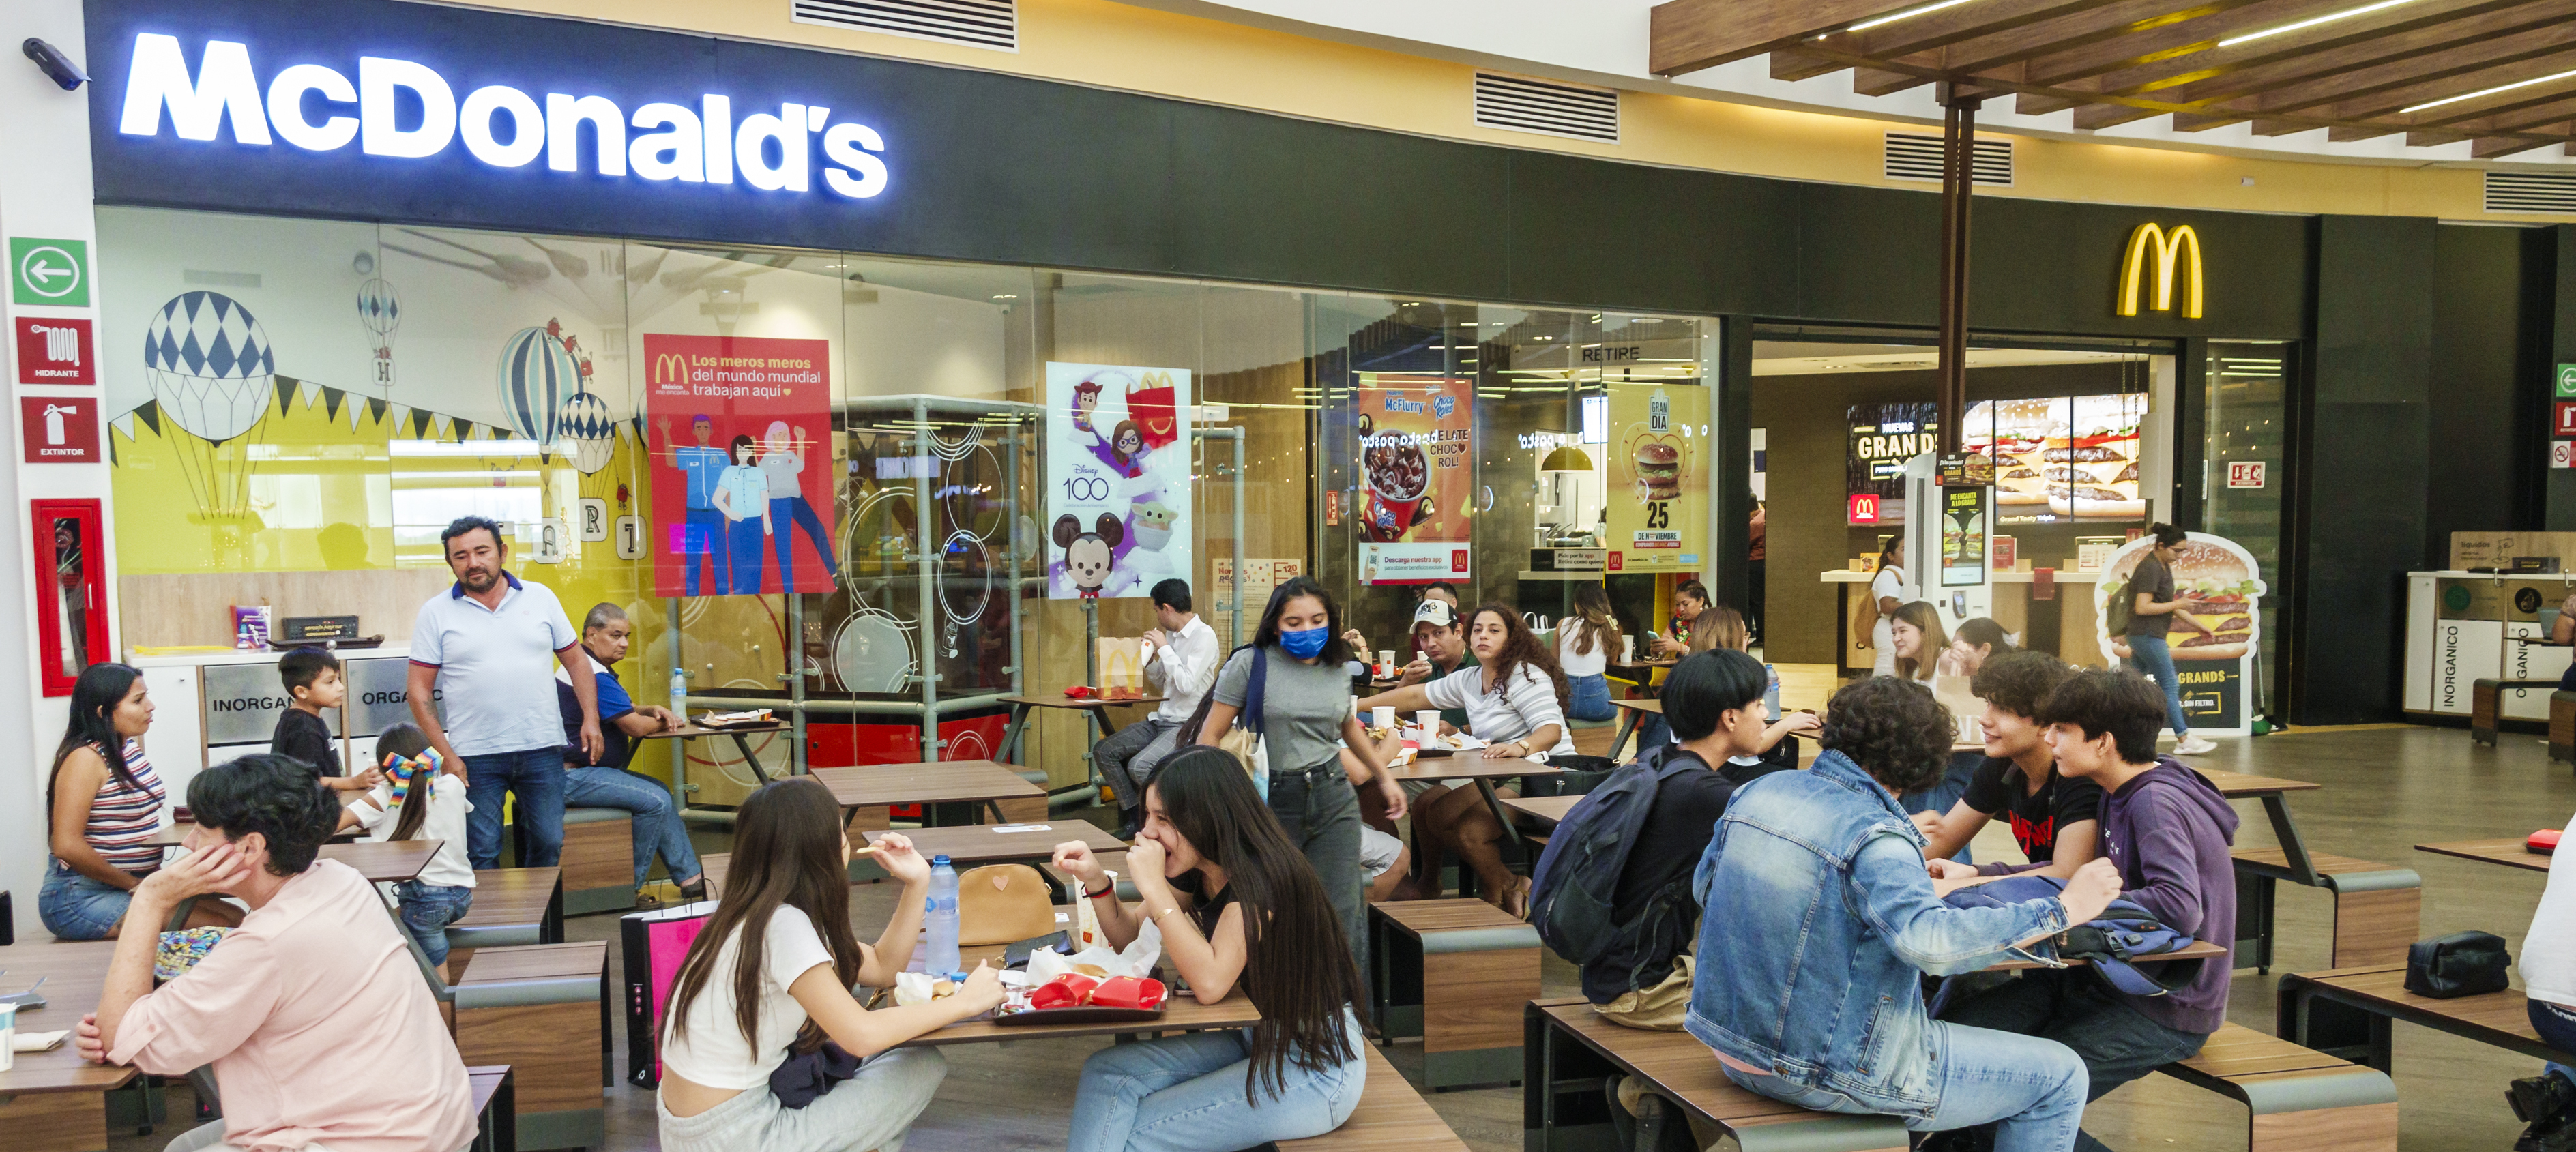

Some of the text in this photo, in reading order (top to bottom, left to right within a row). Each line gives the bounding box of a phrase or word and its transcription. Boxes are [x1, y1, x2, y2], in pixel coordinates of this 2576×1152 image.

[119, 32, 888, 198] McDonald's
[692, 354, 811, 369] Los meros meros
[1583, 346, 1639, 362] RETIRE
[692, 368, 821, 383] del mundo mundial
[693, 383, 781, 400] trabajan aquí
[1386, 398, 1424, 415] McFlurry
[1433, 394, 1455, 409] Choco
[1652, 402, 1667, 413] GRAN
[1436, 404, 1454, 421] Roles
[1652, 413, 1667, 430] DÍA
[1446, 429, 1469, 442] LATE
[1438, 457, 1459, 468] ROL!
[1063, 477, 1109, 501] 100
[1647, 501, 1669, 529] 25
[1218, 564, 1298, 575] Nors 120
[2444, 625, 2459, 707] INORGANICO
[2516, 627, 2529, 698] OGANICO
[2178, 670, 2225, 684] GRANDS
[214, 696, 295, 711] INORGAN
